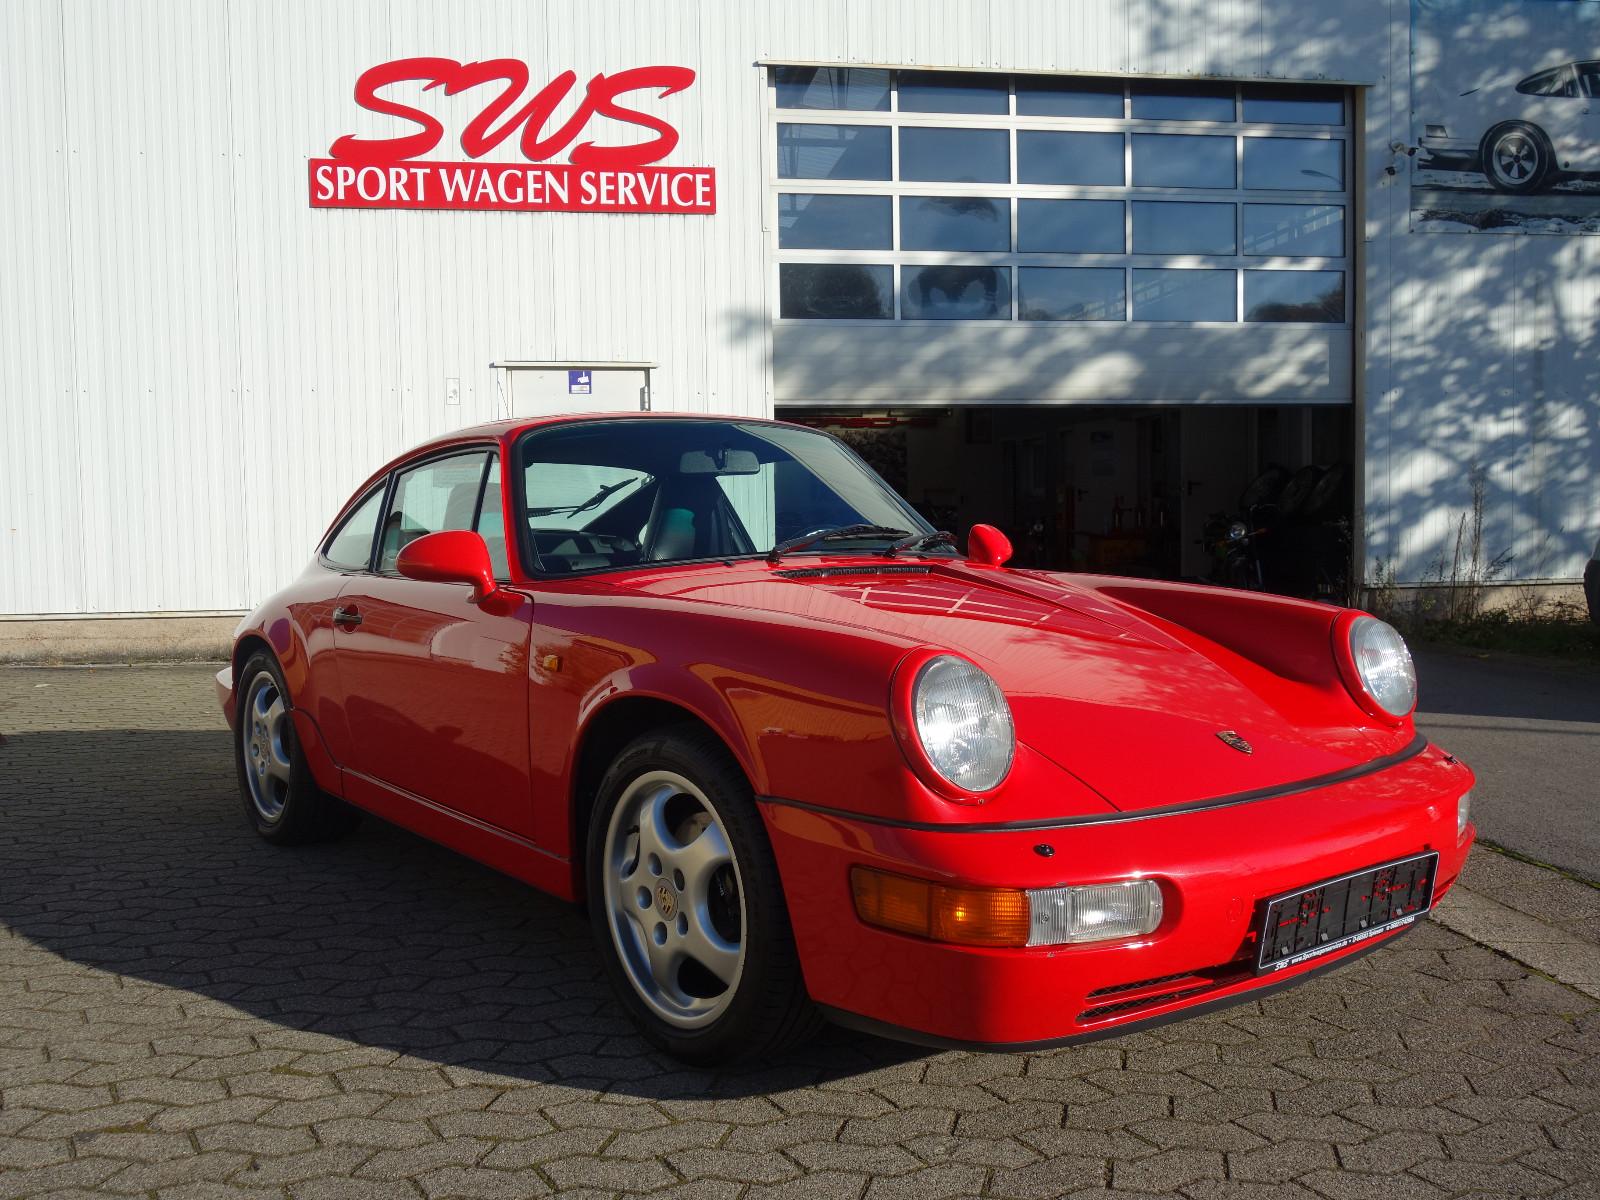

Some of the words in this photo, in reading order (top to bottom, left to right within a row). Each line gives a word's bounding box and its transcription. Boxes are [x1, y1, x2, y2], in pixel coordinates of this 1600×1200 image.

[329, 57, 695, 166] SWS
[316, 165, 430, 201] SPORT
[439, 168, 569, 204] WAGEN
[580, 170, 711, 207] SERVICE
